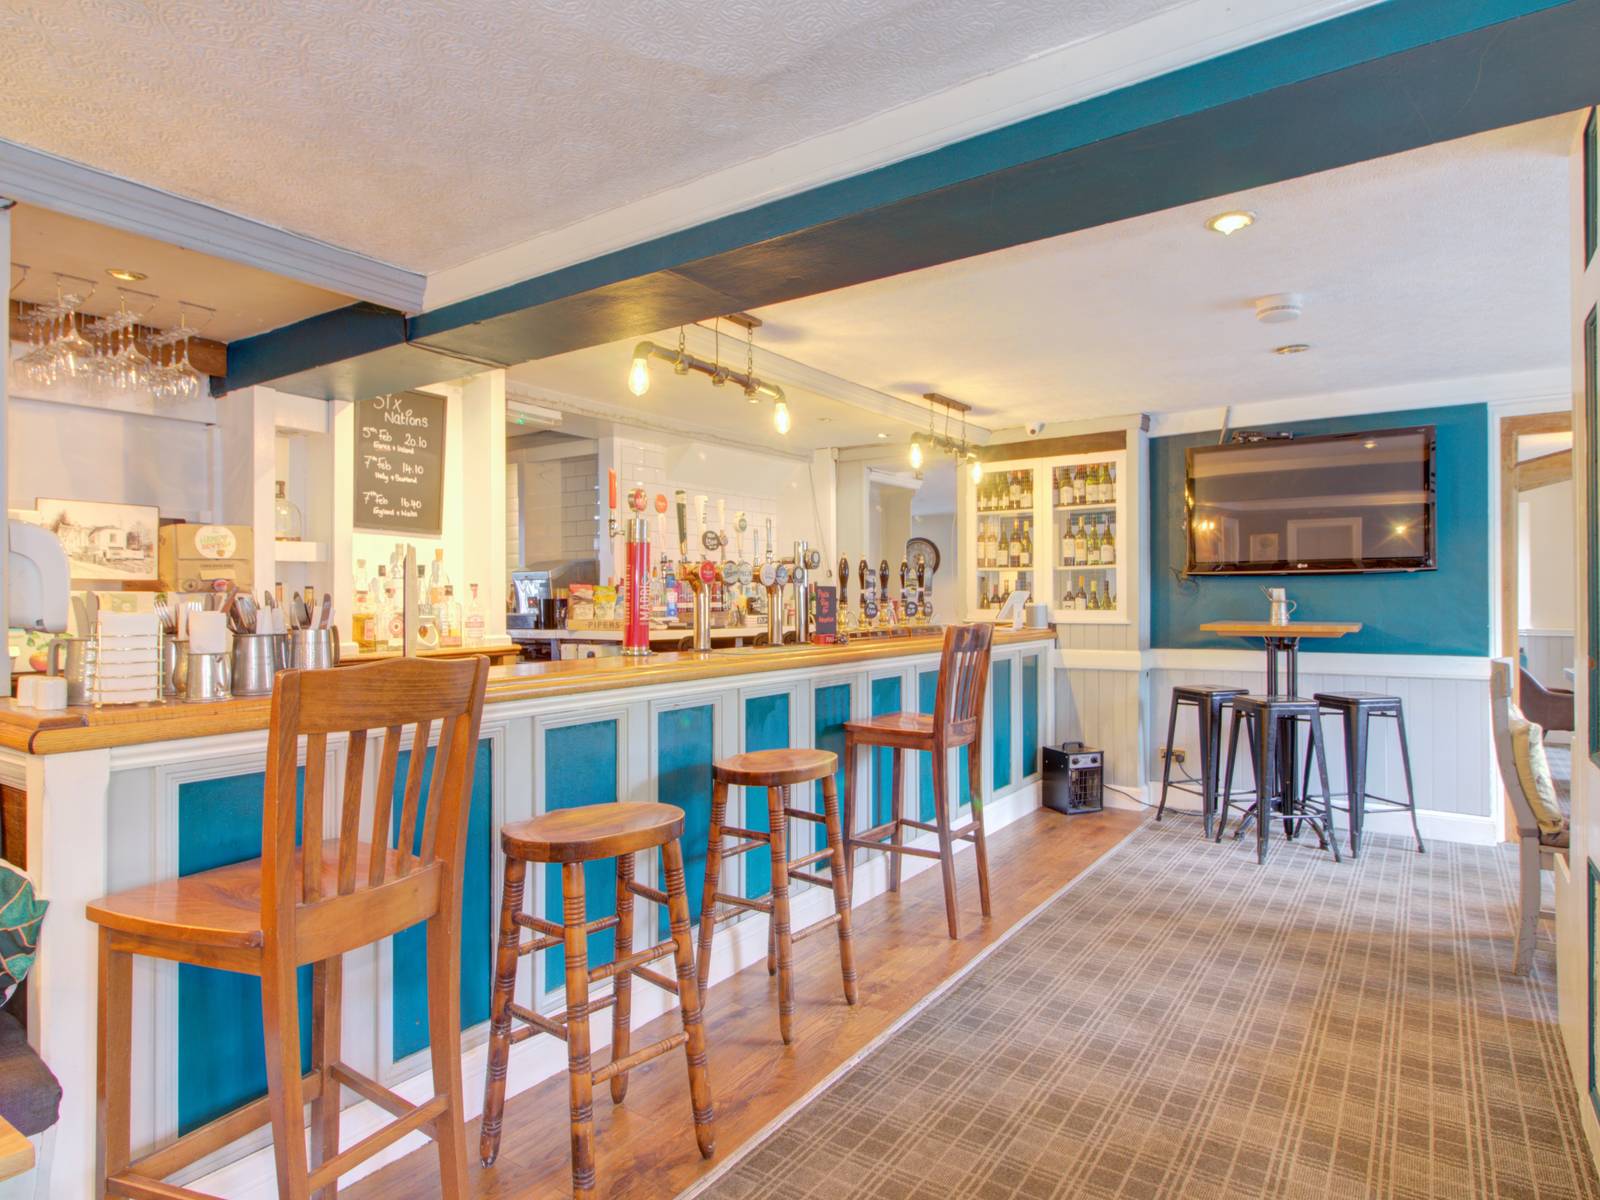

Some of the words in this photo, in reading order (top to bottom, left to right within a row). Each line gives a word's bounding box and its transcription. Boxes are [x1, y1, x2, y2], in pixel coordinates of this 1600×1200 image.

[384, 409, 429, 428] Nations
[378, 429, 393, 442] Feb
[404, 433, 427, 448] 20.10
[377, 457, 392, 471] Feb
[402, 462, 424, 475] 14.10
[375, 494, 389, 505] Feb
